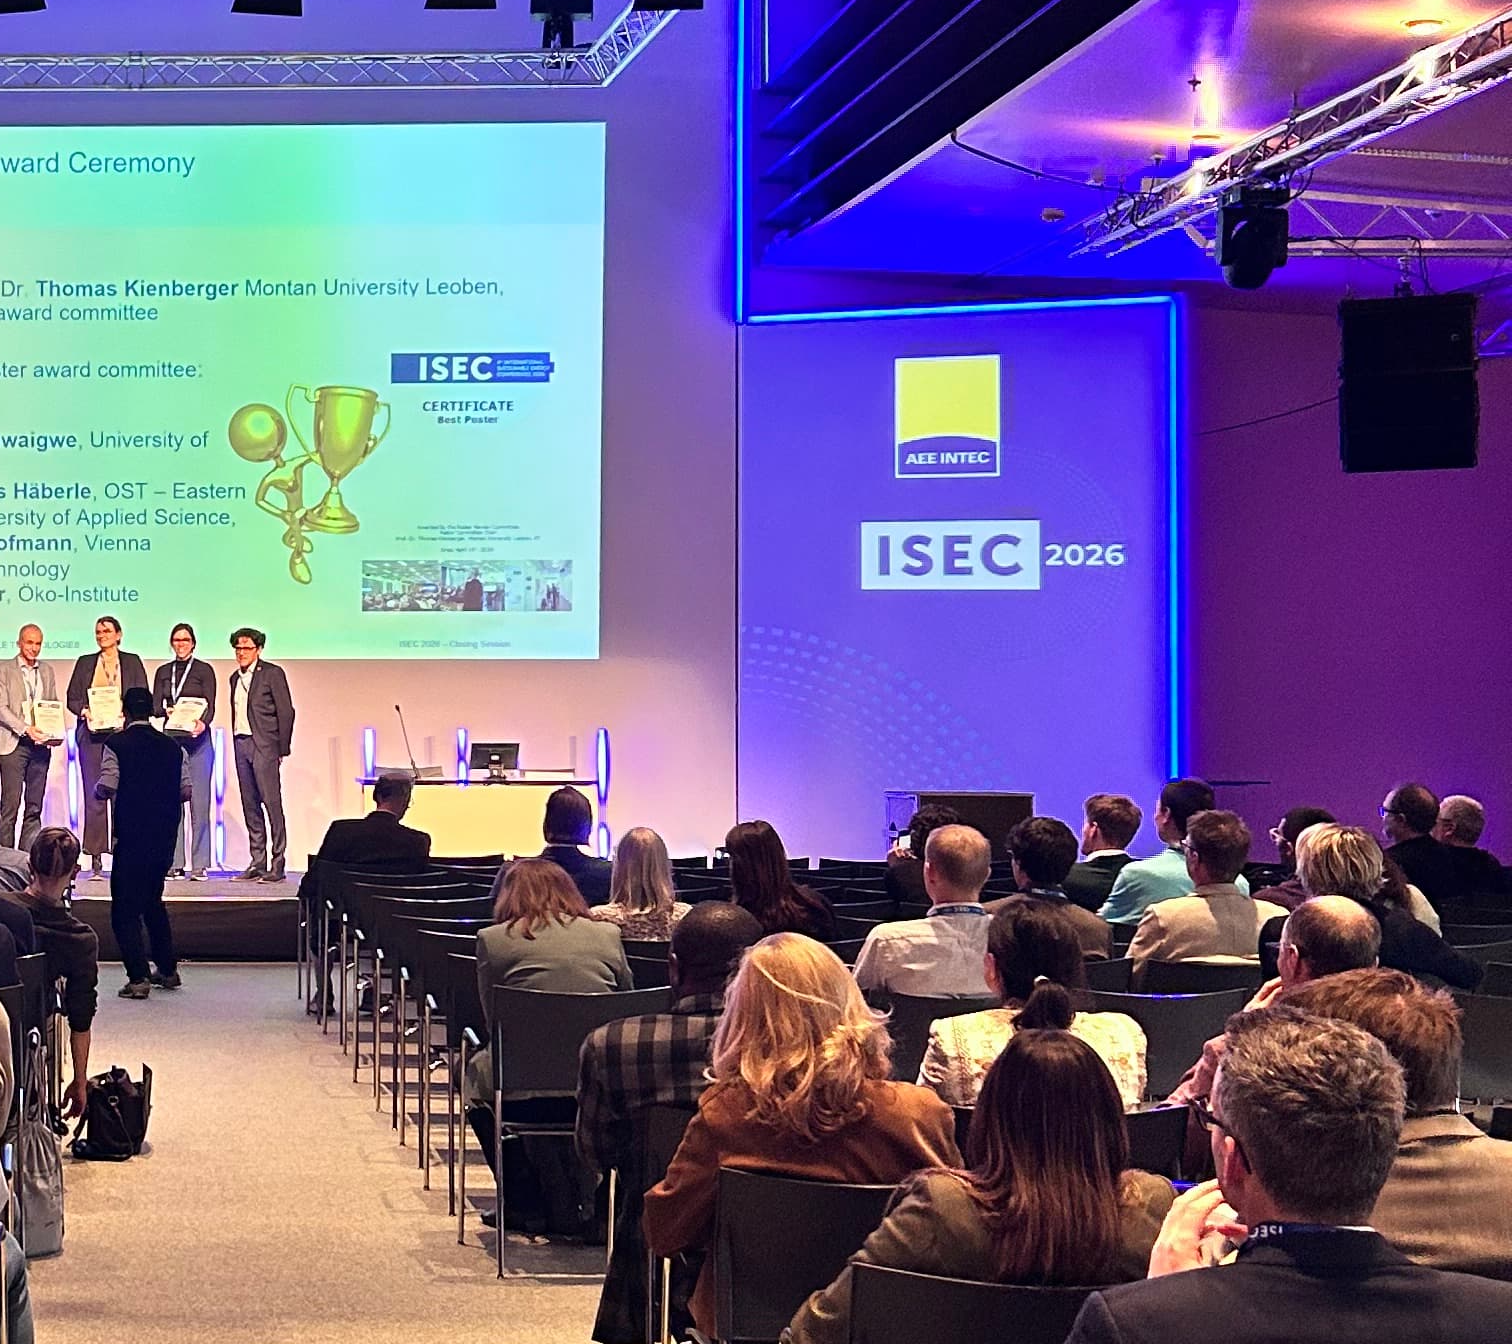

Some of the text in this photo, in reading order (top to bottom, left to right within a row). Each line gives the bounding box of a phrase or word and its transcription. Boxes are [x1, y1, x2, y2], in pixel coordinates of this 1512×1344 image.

[69, 152, 195, 177] Ceremony
[36, 280, 117, 297] Thomas
[125, 280, 238, 301] Kienberger
[246, 279, 316, 296] Montan
[325, 279, 419, 300] University
[426, 278, 505, 299] Leoben,
[60, 305, 158, 321] committee
[34, 362, 90, 378] award
[98, 362, 202, 378] committee:
[419, 356, 493, 381] ISEC
[422, 401, 514, 412] CERTIFICATE
[438, 416, 461, 424] Best
[91, 431, 184, 453] University
[191, 431, 209, 449] of
[905, 451, 991, 465] AEE INTEC
[14, 482, 97, 503] Häberle,
[105, 483, 147, 500] OST
[173, 483, 246, 500] Eastern
[53, 509, 71, 526] of
[76, 509, 147, 530] Applied
[155, 509, 236, 529] Science,
[85, 535, 151, 552] Vienna
[877, 533, 1126, 577] ISEC 2026
[19, 583, 139, 603] Öko-Institute
